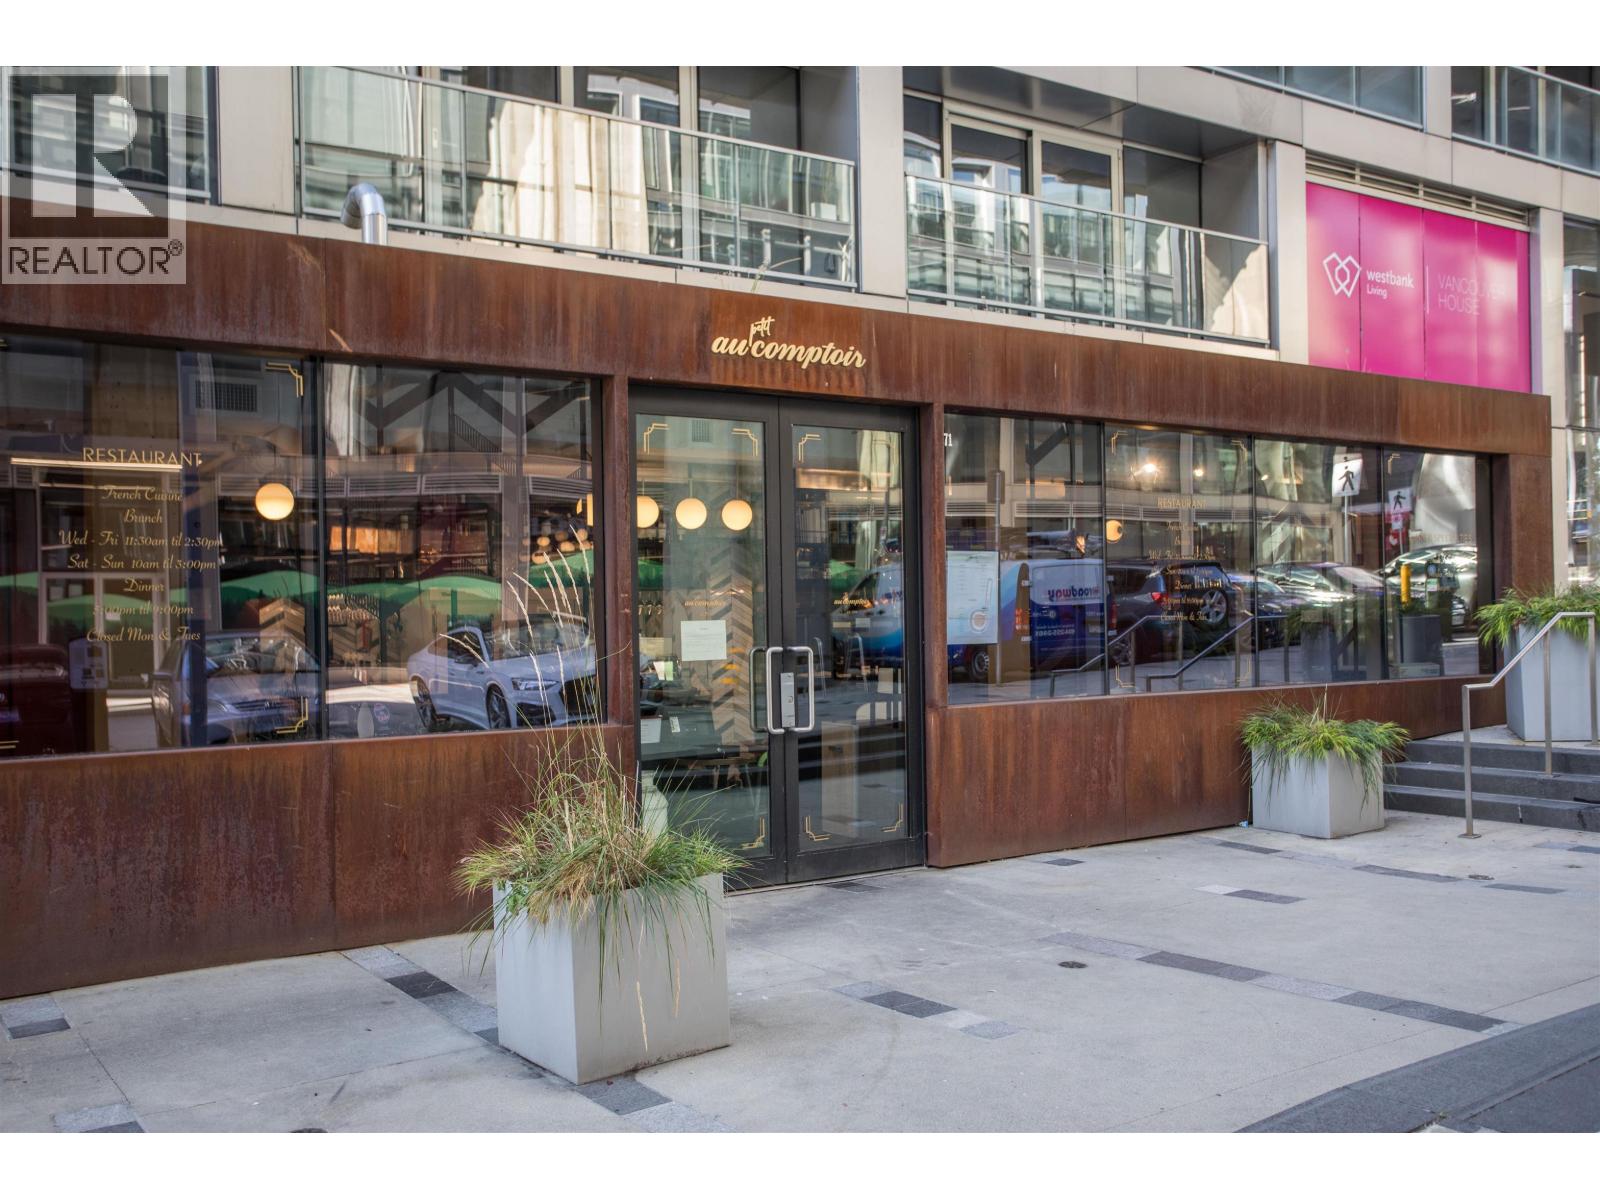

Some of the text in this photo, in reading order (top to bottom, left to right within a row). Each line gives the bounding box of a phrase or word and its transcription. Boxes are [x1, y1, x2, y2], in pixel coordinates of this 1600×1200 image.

[1366, 269, 1415, 289] westbank
[1438, 273, 1506, 300] VANCOER
[1366, 283, 1388, 300] Living
[1438, 292, 1480, 316] HOUSE
[711, 336, 866, 369] au comptoir
[83, 447, 202, 467] RESTAURANT
[102, 485, 141, 500] French
[123, 509, 163, 524] Brunch
[59, 529, 88, 545] Wed
[98, 530, 119, 546] Fri
[171, 531, 183, 546] til
[68, 553, 88, 569] Sat
[101, 553, 124, 569] Sun
[131, 559, 159, 569] 10am
[123, 576, 165, 592] Dinner
[86, 626, 124, 642] Closed
[127, 626, 154, 641] Mon
[158, 629, 171, 642] &
